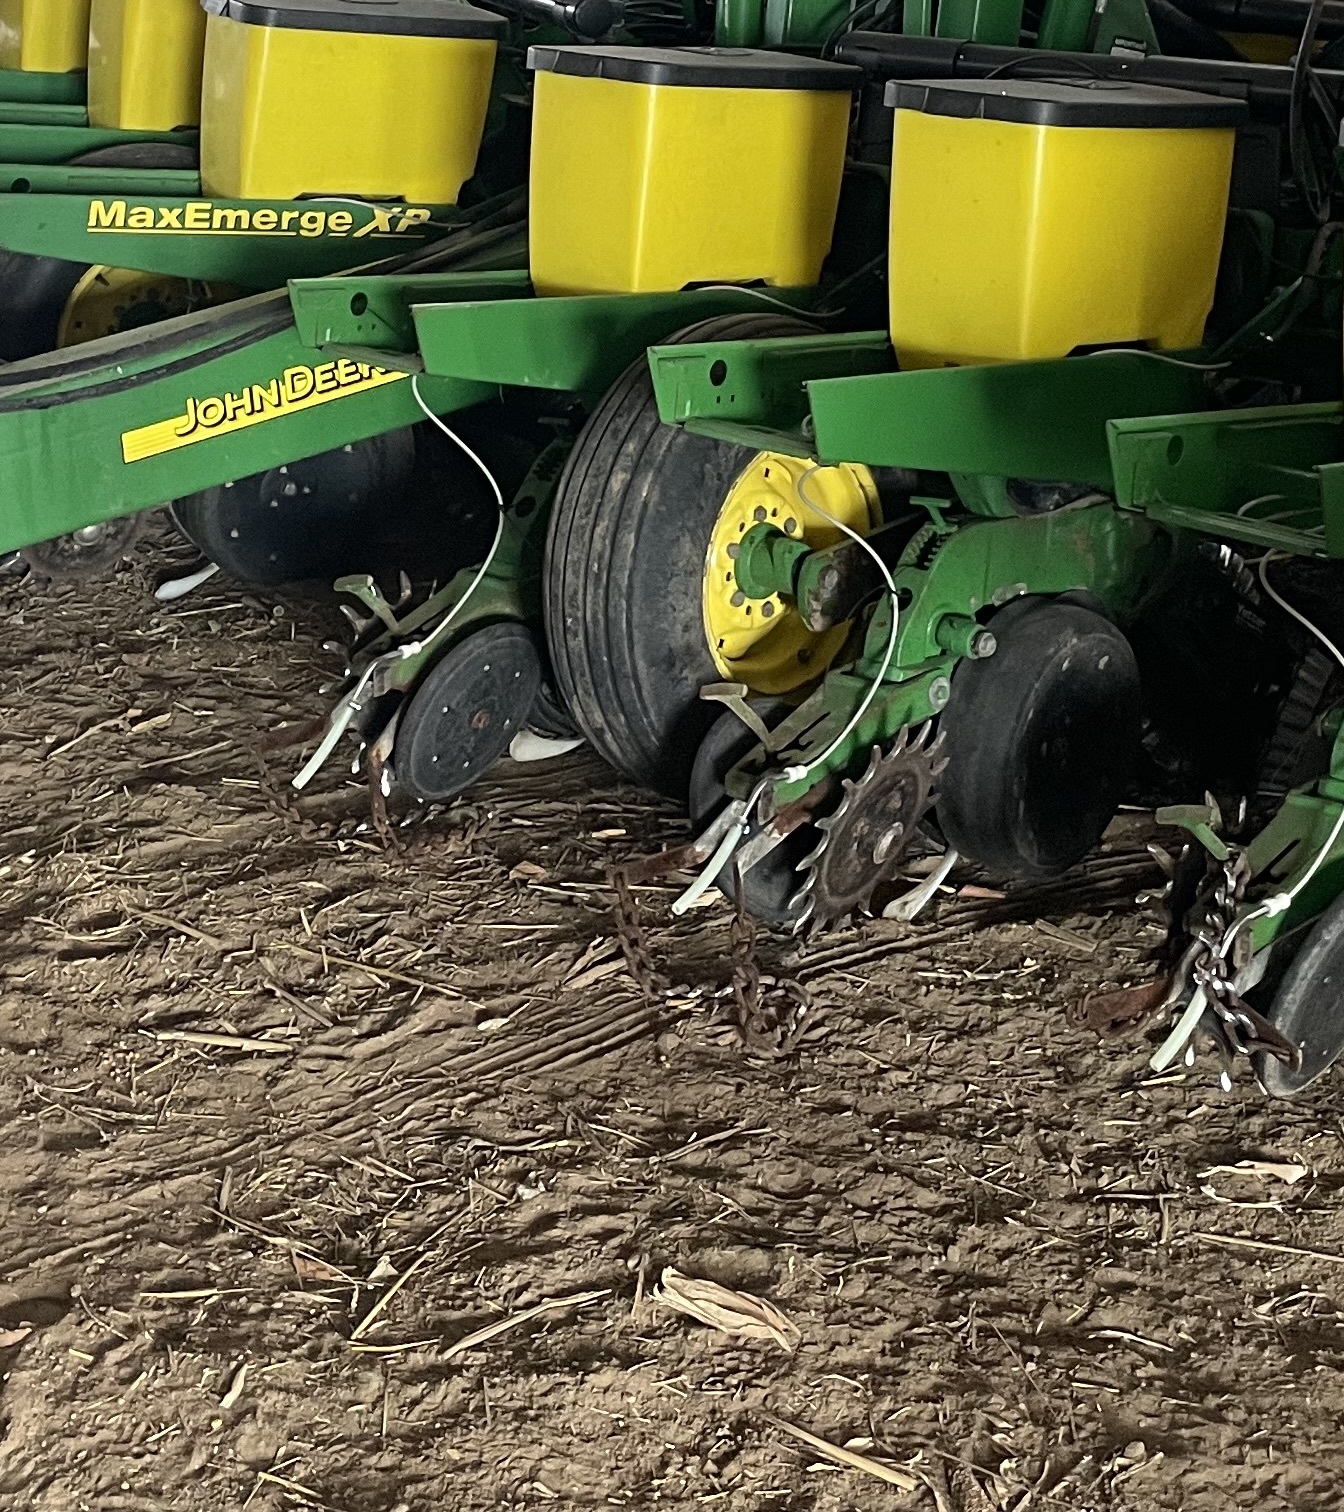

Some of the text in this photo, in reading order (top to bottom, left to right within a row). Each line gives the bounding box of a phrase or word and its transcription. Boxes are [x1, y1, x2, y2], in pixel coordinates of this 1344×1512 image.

[88, 200, 432, 238] MaxEmerge XP
[175, 378, 282, 437] JOHN
